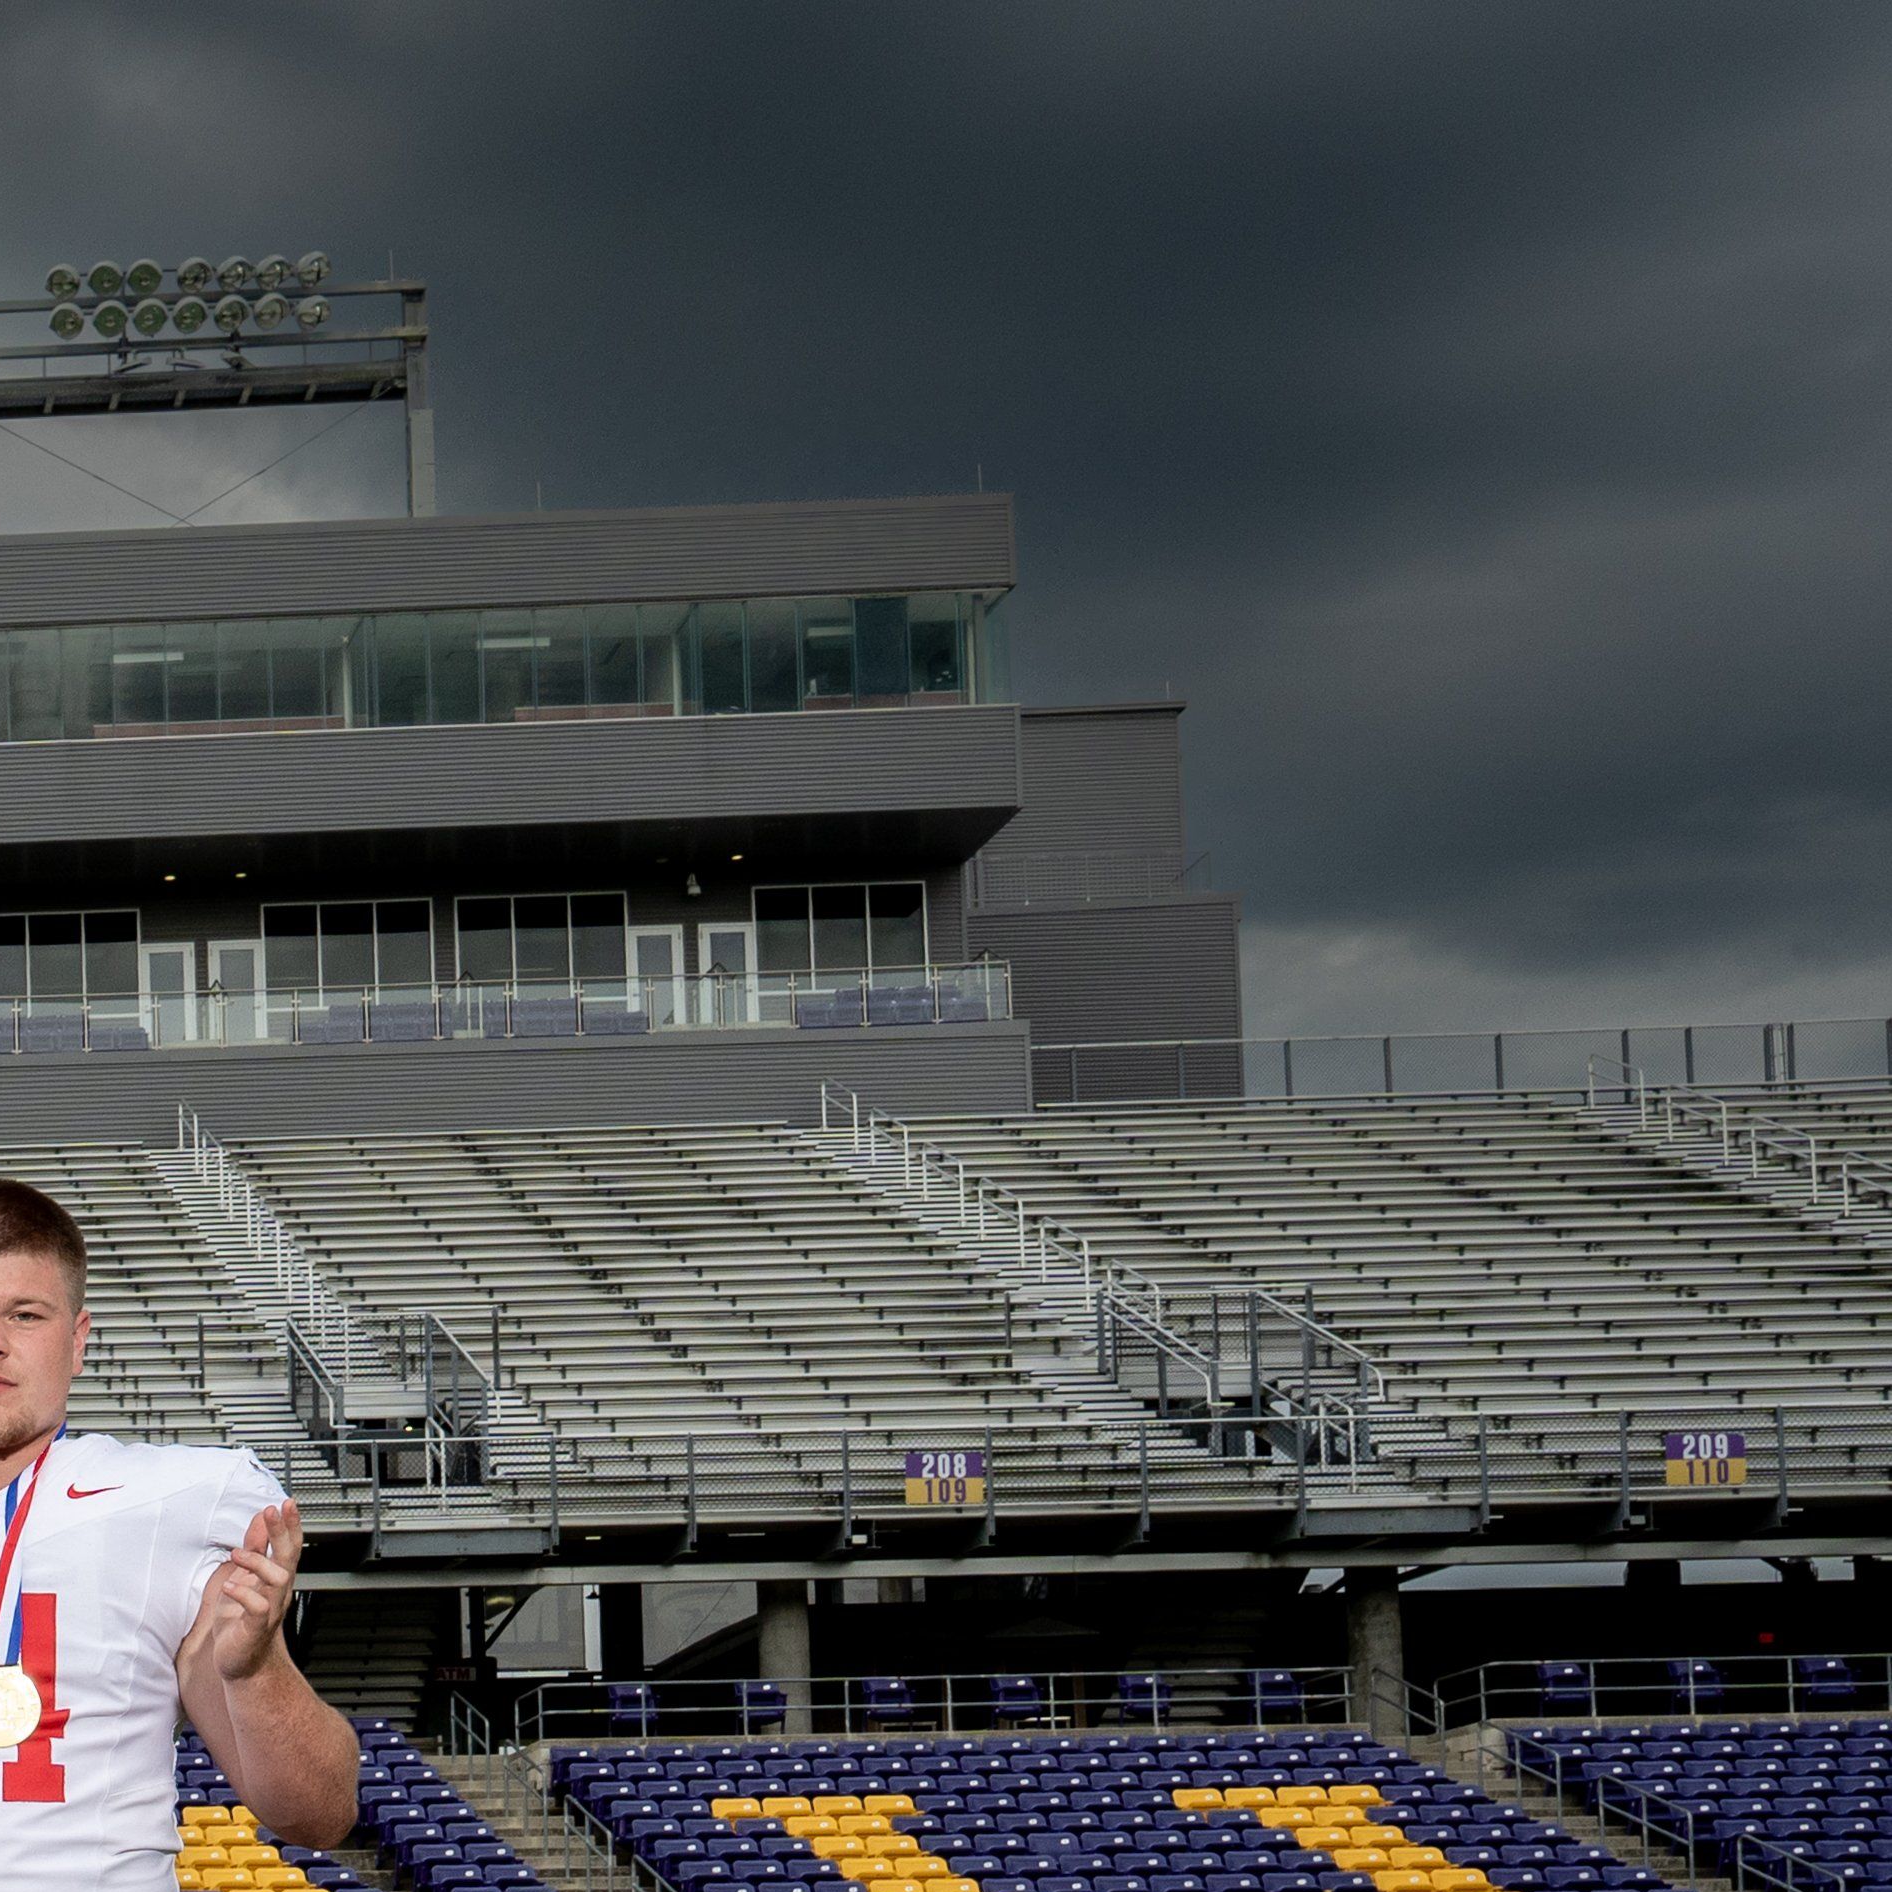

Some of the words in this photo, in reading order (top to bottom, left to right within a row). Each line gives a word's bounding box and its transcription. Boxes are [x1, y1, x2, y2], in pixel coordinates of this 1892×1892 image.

[1683, 1433, 1729, 1460] 209
[921, 1453, 966, 1478] 208
[1686, 1460, 1729, 1485] 110
[924, 1479, 966, 1504] 109
